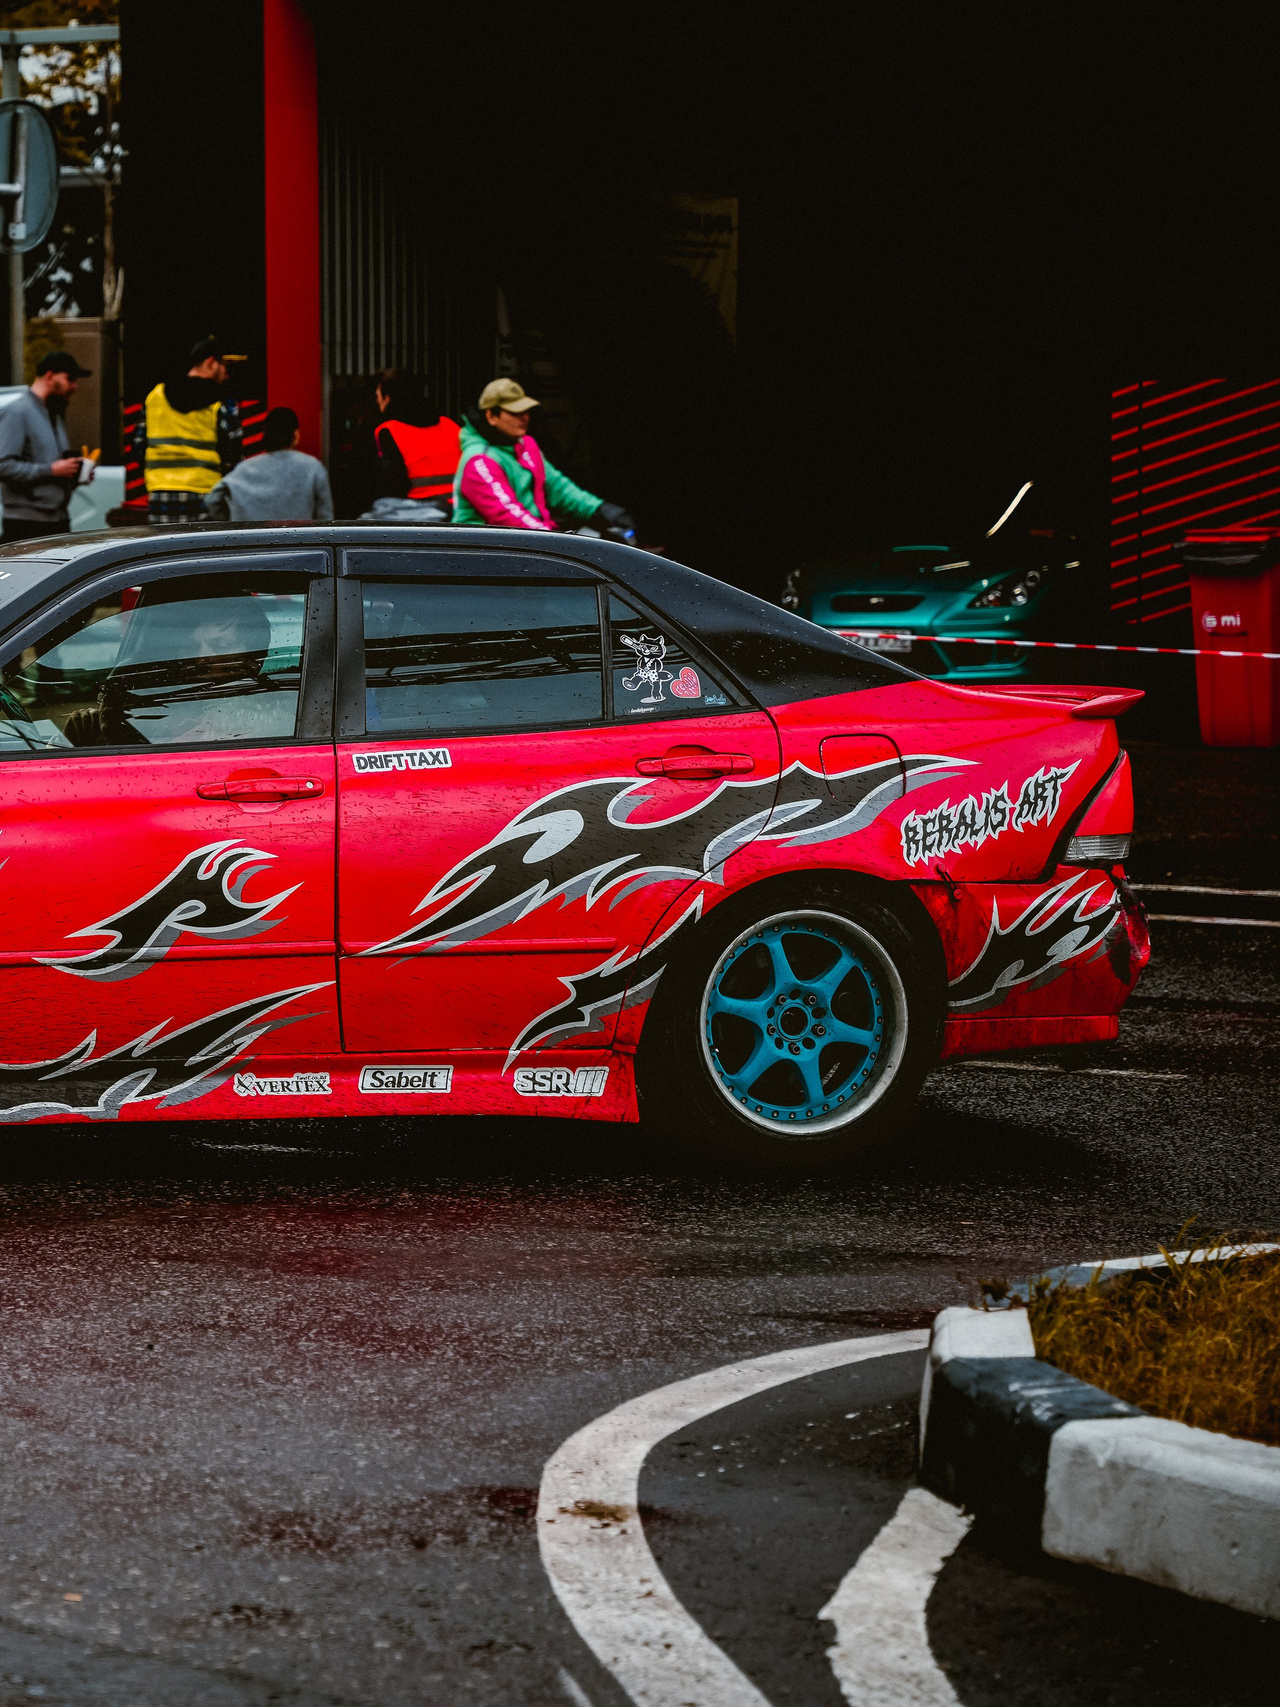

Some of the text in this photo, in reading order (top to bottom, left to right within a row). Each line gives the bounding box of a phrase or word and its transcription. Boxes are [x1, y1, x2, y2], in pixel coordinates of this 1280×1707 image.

[1014, 765, 1073, 831] ART
[255, 1080, 329, 1093] VERTEX
[370, 1070, 438, 1088] Sabelt
